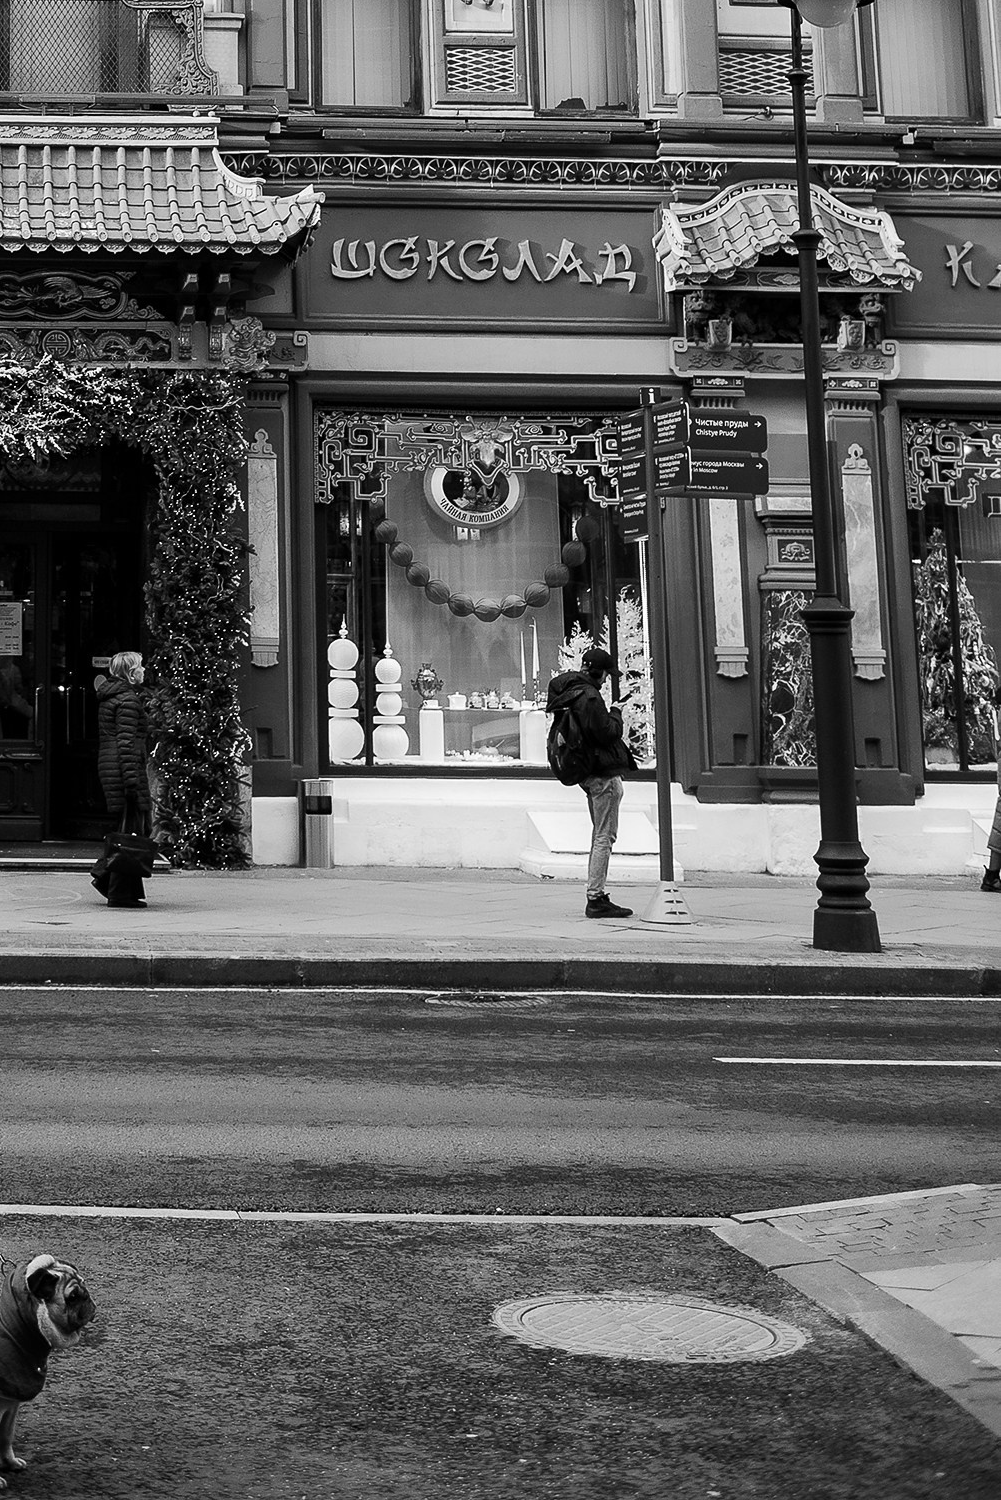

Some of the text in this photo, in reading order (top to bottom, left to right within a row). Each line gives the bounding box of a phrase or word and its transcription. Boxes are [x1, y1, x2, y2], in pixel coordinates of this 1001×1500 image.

[331, 235, 636, 293] ШОКОЛАД
[695, 418, 749, 429] Чистые пруды
[695, 429, 737, 438] Chistye Prudy
[469, 504, 509, 523] КОМПАНИЯ
